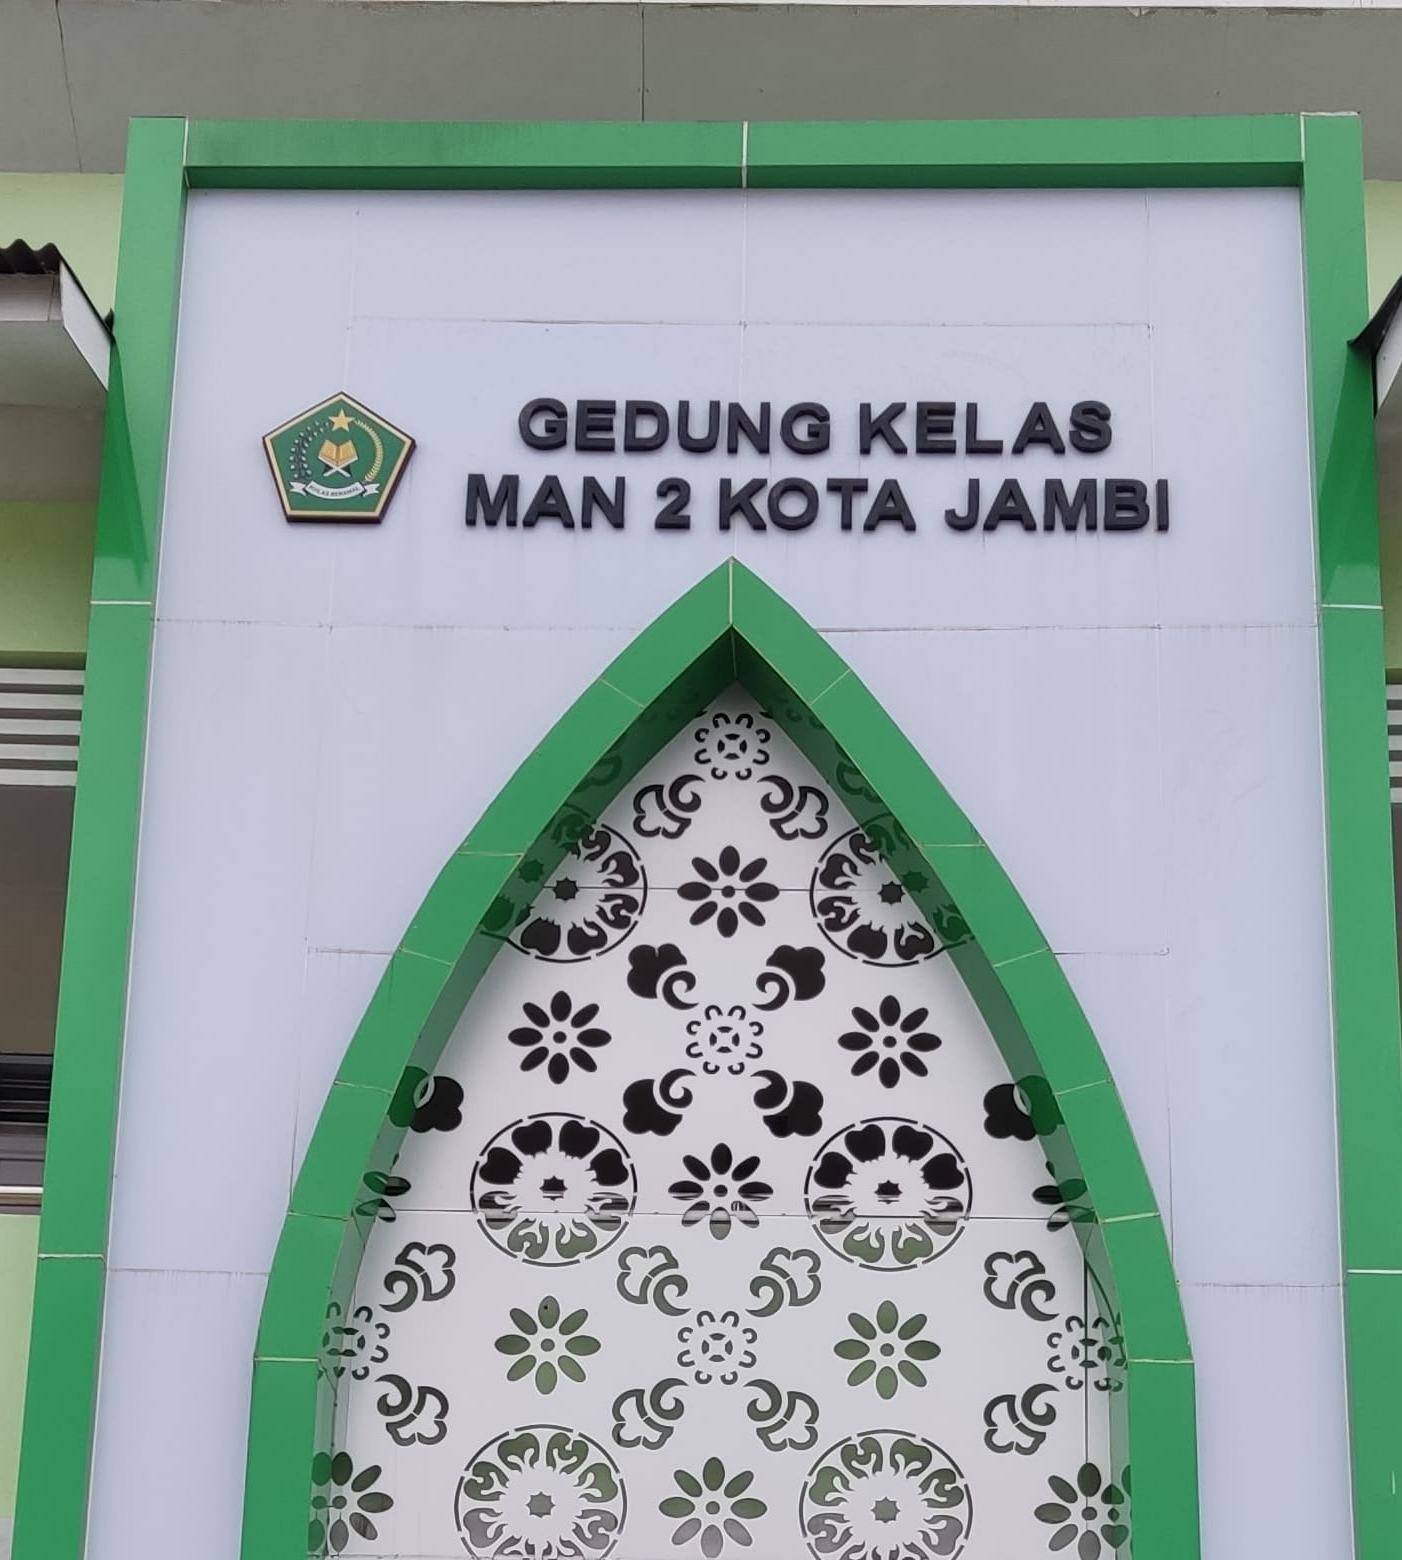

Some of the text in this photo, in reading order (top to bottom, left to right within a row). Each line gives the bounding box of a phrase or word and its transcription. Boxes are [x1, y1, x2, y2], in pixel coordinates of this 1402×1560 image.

[518, 398, 1112, 456] GEDUNG KELAS
[465, 473, 1170, 532] MAN 2 KOTA JAMBI
